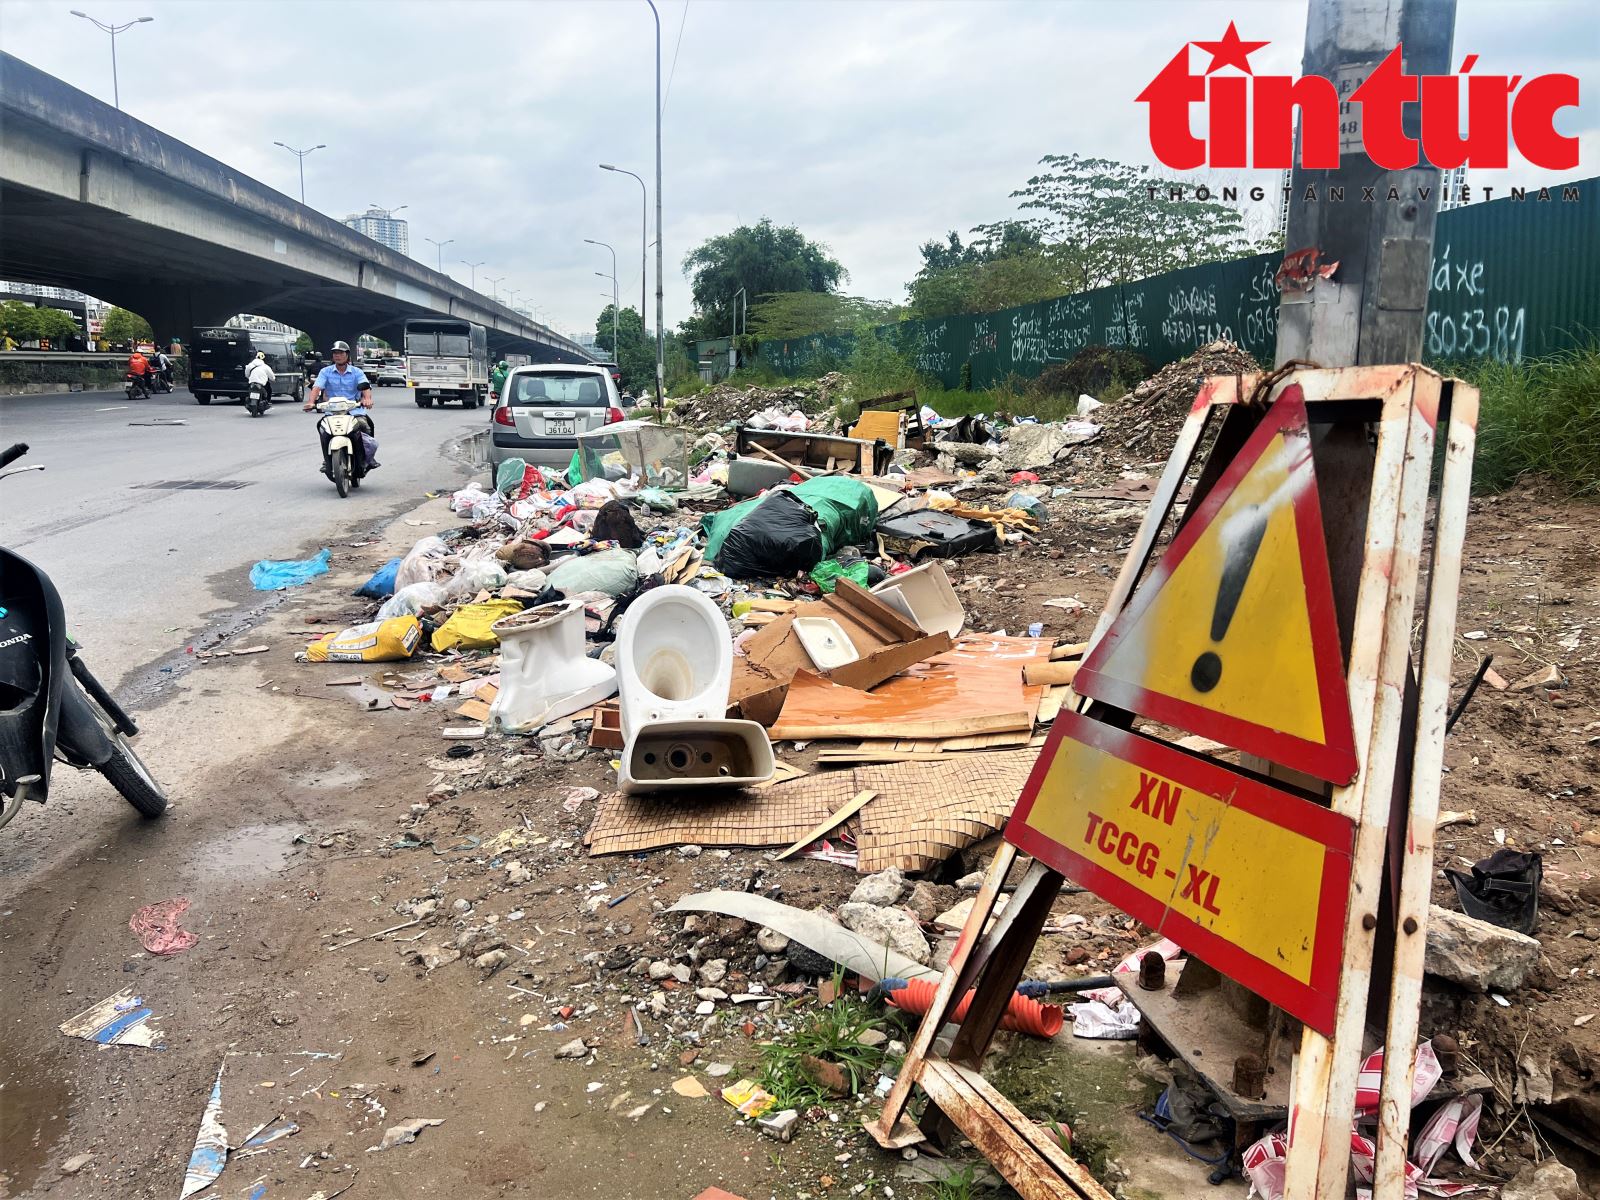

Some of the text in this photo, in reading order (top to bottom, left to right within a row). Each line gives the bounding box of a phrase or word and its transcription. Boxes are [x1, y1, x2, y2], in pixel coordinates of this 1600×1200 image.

[1130, 771, 1183, 827] XN
[1083, 811, 1161, 880] TCCG
[1179, 862, 1222, 917] XL
